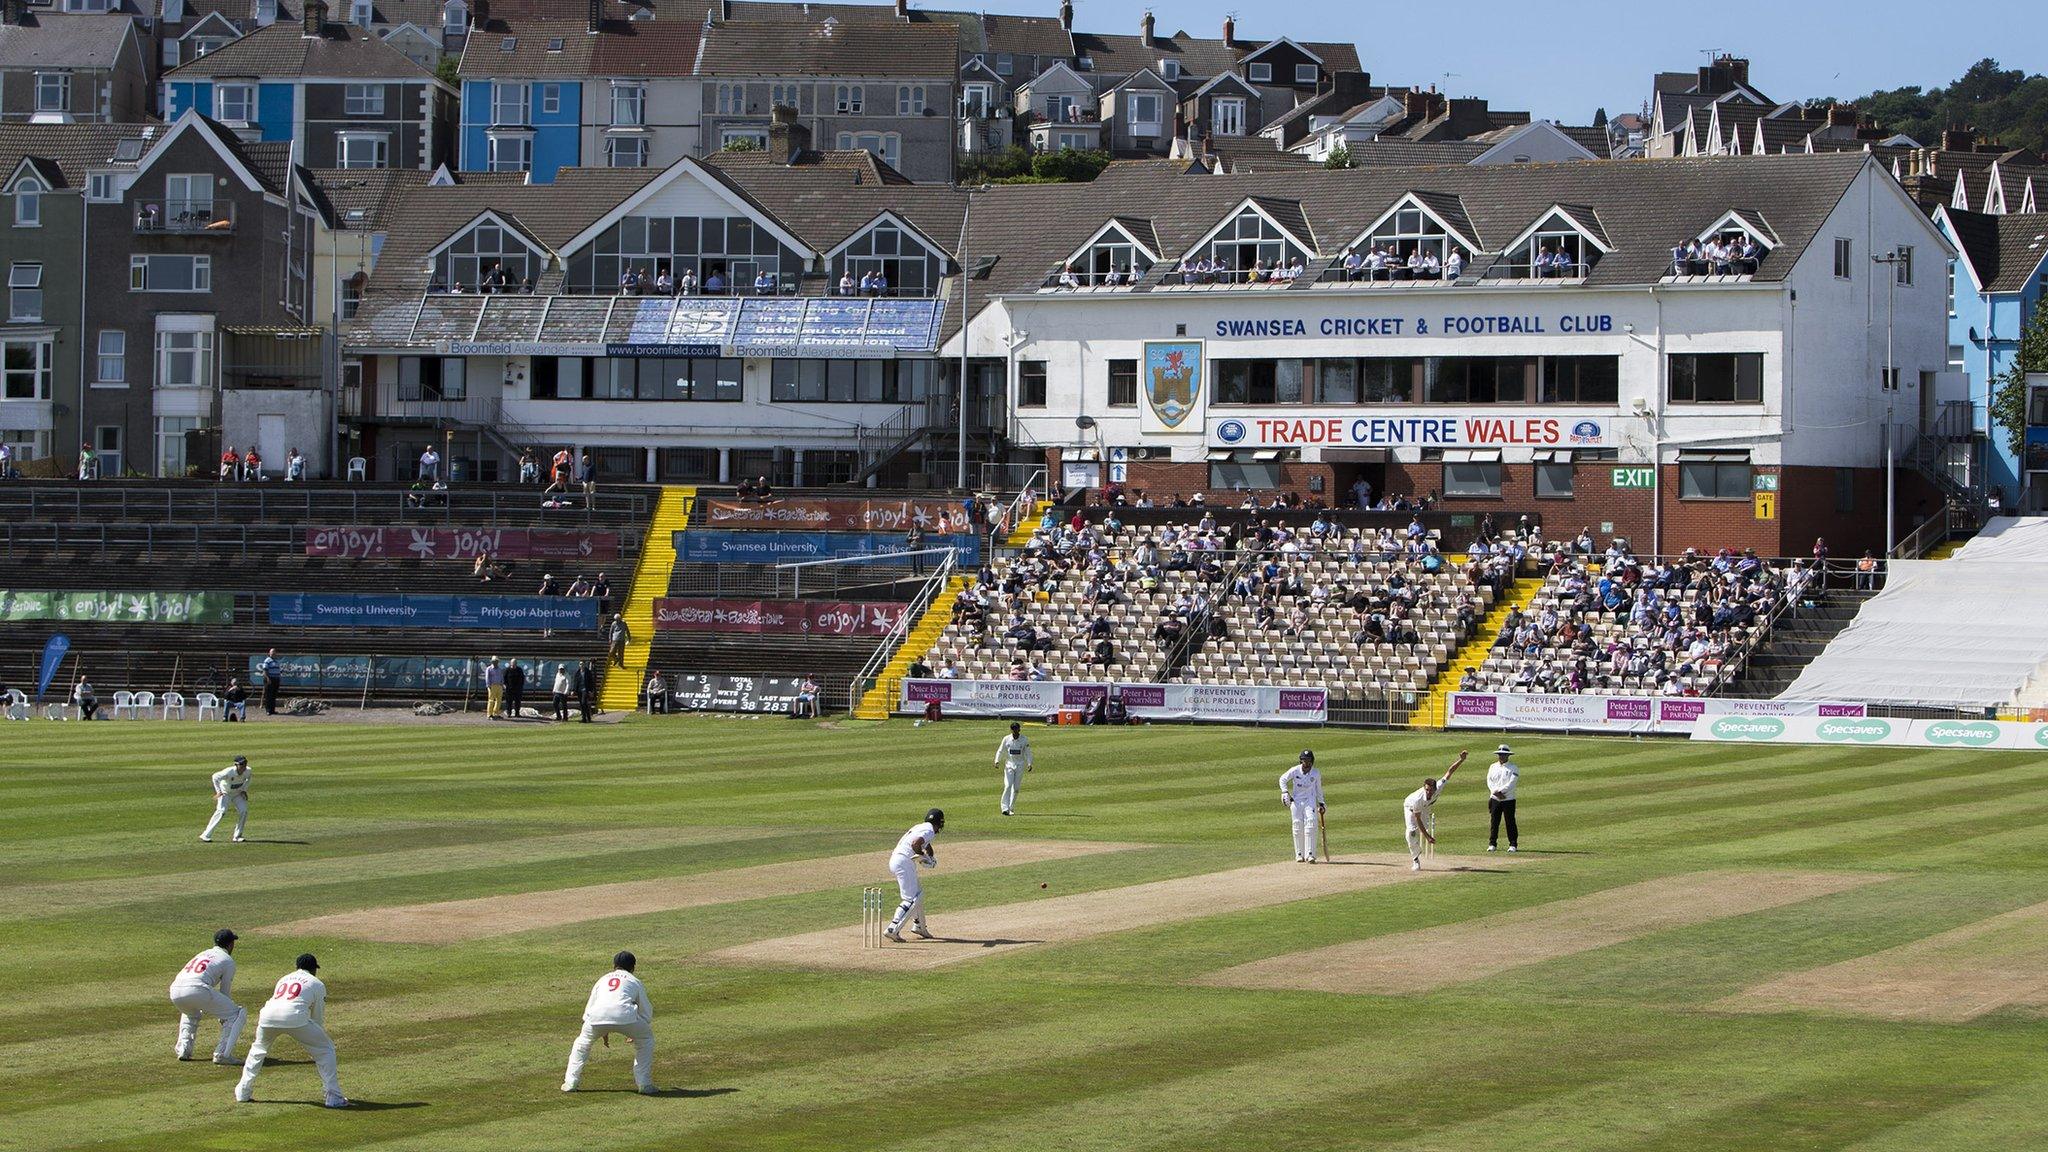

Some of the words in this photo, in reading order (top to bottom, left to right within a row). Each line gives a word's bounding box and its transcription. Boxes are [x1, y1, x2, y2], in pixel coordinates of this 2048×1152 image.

[1216, 320, 1306, 337] SWANSEA
[1320, 318, 1404, 335] CRICKET
[1416, 318, 1428, 334] &
[1444, 316, 1545, 333] FOOTBALL
[1560, 315, 1613, 332] CLUB
[451, 342, 512, 354] Broomfield
[515, 343, 569, 355] Alexander
[608, 345, 719, 356] www.broomfield.co.uk
[736, 344, 798, 357] Broomfield
[800, 345, 857, 357] Alexander
[1256, 420, 1343, 443] TRADE
[1351, 419, 1457, 443] CENTRE
[1465, 419, 1560, 443] WALES
[1613, 469, 1654, 487] EXIT
[863, 502, 907, 529] enjoy!
[1761, 502, 1767, 518] 1
[314, 528, 383, 558] enjoy!
[721, 541, 767, 552] Swansea
[769, 541, 819, 555] University
[75, 593, 123, 619] enjoy!
[316, 603, 363, 615] Swansea
[366, 604, 418, 618] University
[481, 606, 526, 619] Prifysgol
[529, 607, 581, 618] Abertawe
[818, 604, 866, 633] enjoy!
[699, 674, 708, 684] 3
[791, 677, 799, 688] 4
[702, 683, 711, 693] 5
[910, 684, 929, 693] Peter
[930, 685, 949, 695] Lynn
[980, 684, 1031, 692] PREVENTING
[1065, 688, 1085, 696] Peter
[1193, 688, 1247, 696] PREVENTING
[741, 692, 749, 701] 2
[970, 692, 995, 700] LEGAL
[997, 692, 1041, 700] PROBLEMS
[1122, 689, 1142, 697] Peter
[1143, 689, 1162, 700] Lynn
[1282, 693, 1301, 701] Peter
[1302, 694, 1322, 704] Lynn
[740, 701, 756, 711] 38
[763, 701, 788, 711] 283
[1212, 697, 1257, 705] PROBLEMS
[1456, 697, 1475, 706] Peter
[1476, 698, 1495, 709] Lynn
[1525, 697, 1575, 705] PREVENTING
[1733, 702, 1786, 711] PREVENTING
[1462, 706, 1494, 714] PARTNERS
[1610, 702, 1628, 710] Peter
[1629, 703, 1648, 713] Lynn
[1663, 703, 1681, 711] Peter
[1683, 703, 1702, 714] Lynn
[1821, 707, 1840, 716] Peter
[1615, 710, 1648, 718] PARTNERS
[1718, 722, 1779, 733] Specsavers
[1822, 723, 1884, 735] Specsavers
[1931, 726, 1993, 739] Specsavers
[185, 958, 209, 974] 46
[608, 977, 621, 992] 9
[274, 982, 302, 1000] 99
